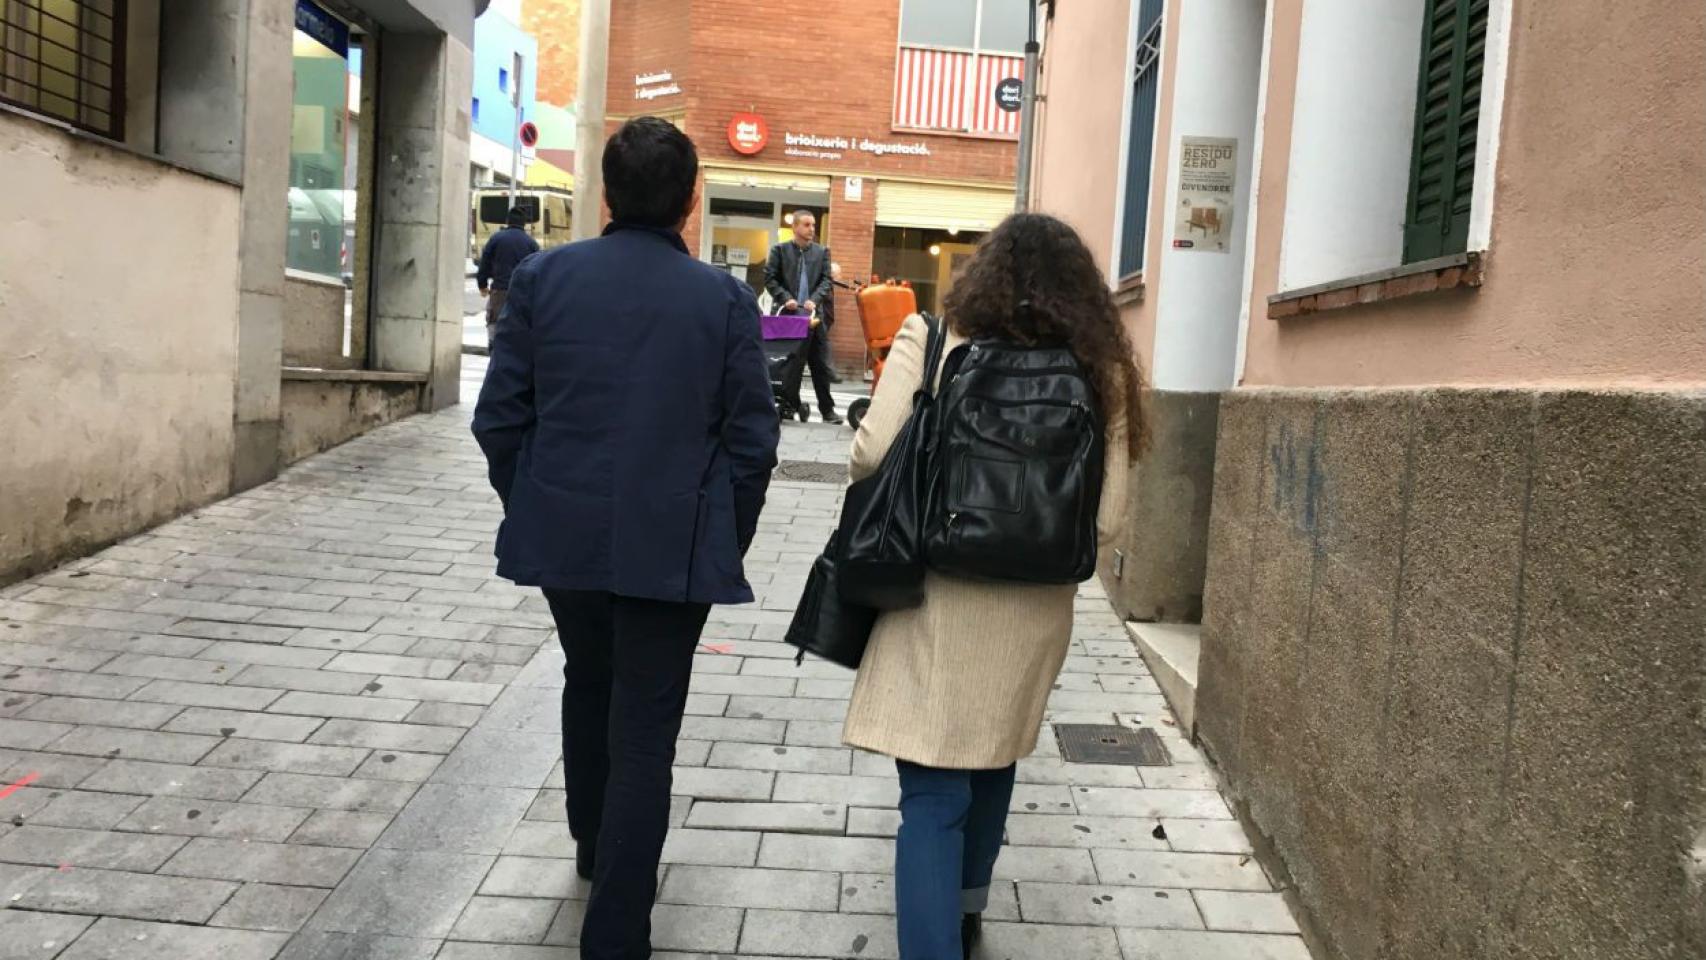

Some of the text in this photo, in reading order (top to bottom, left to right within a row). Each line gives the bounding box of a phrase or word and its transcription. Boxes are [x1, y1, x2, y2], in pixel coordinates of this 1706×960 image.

[851, 137, 857, 150] i
[1184, 147, 1232, 160] RESIDU
[1183, 157, 1217, 169] ZERO
